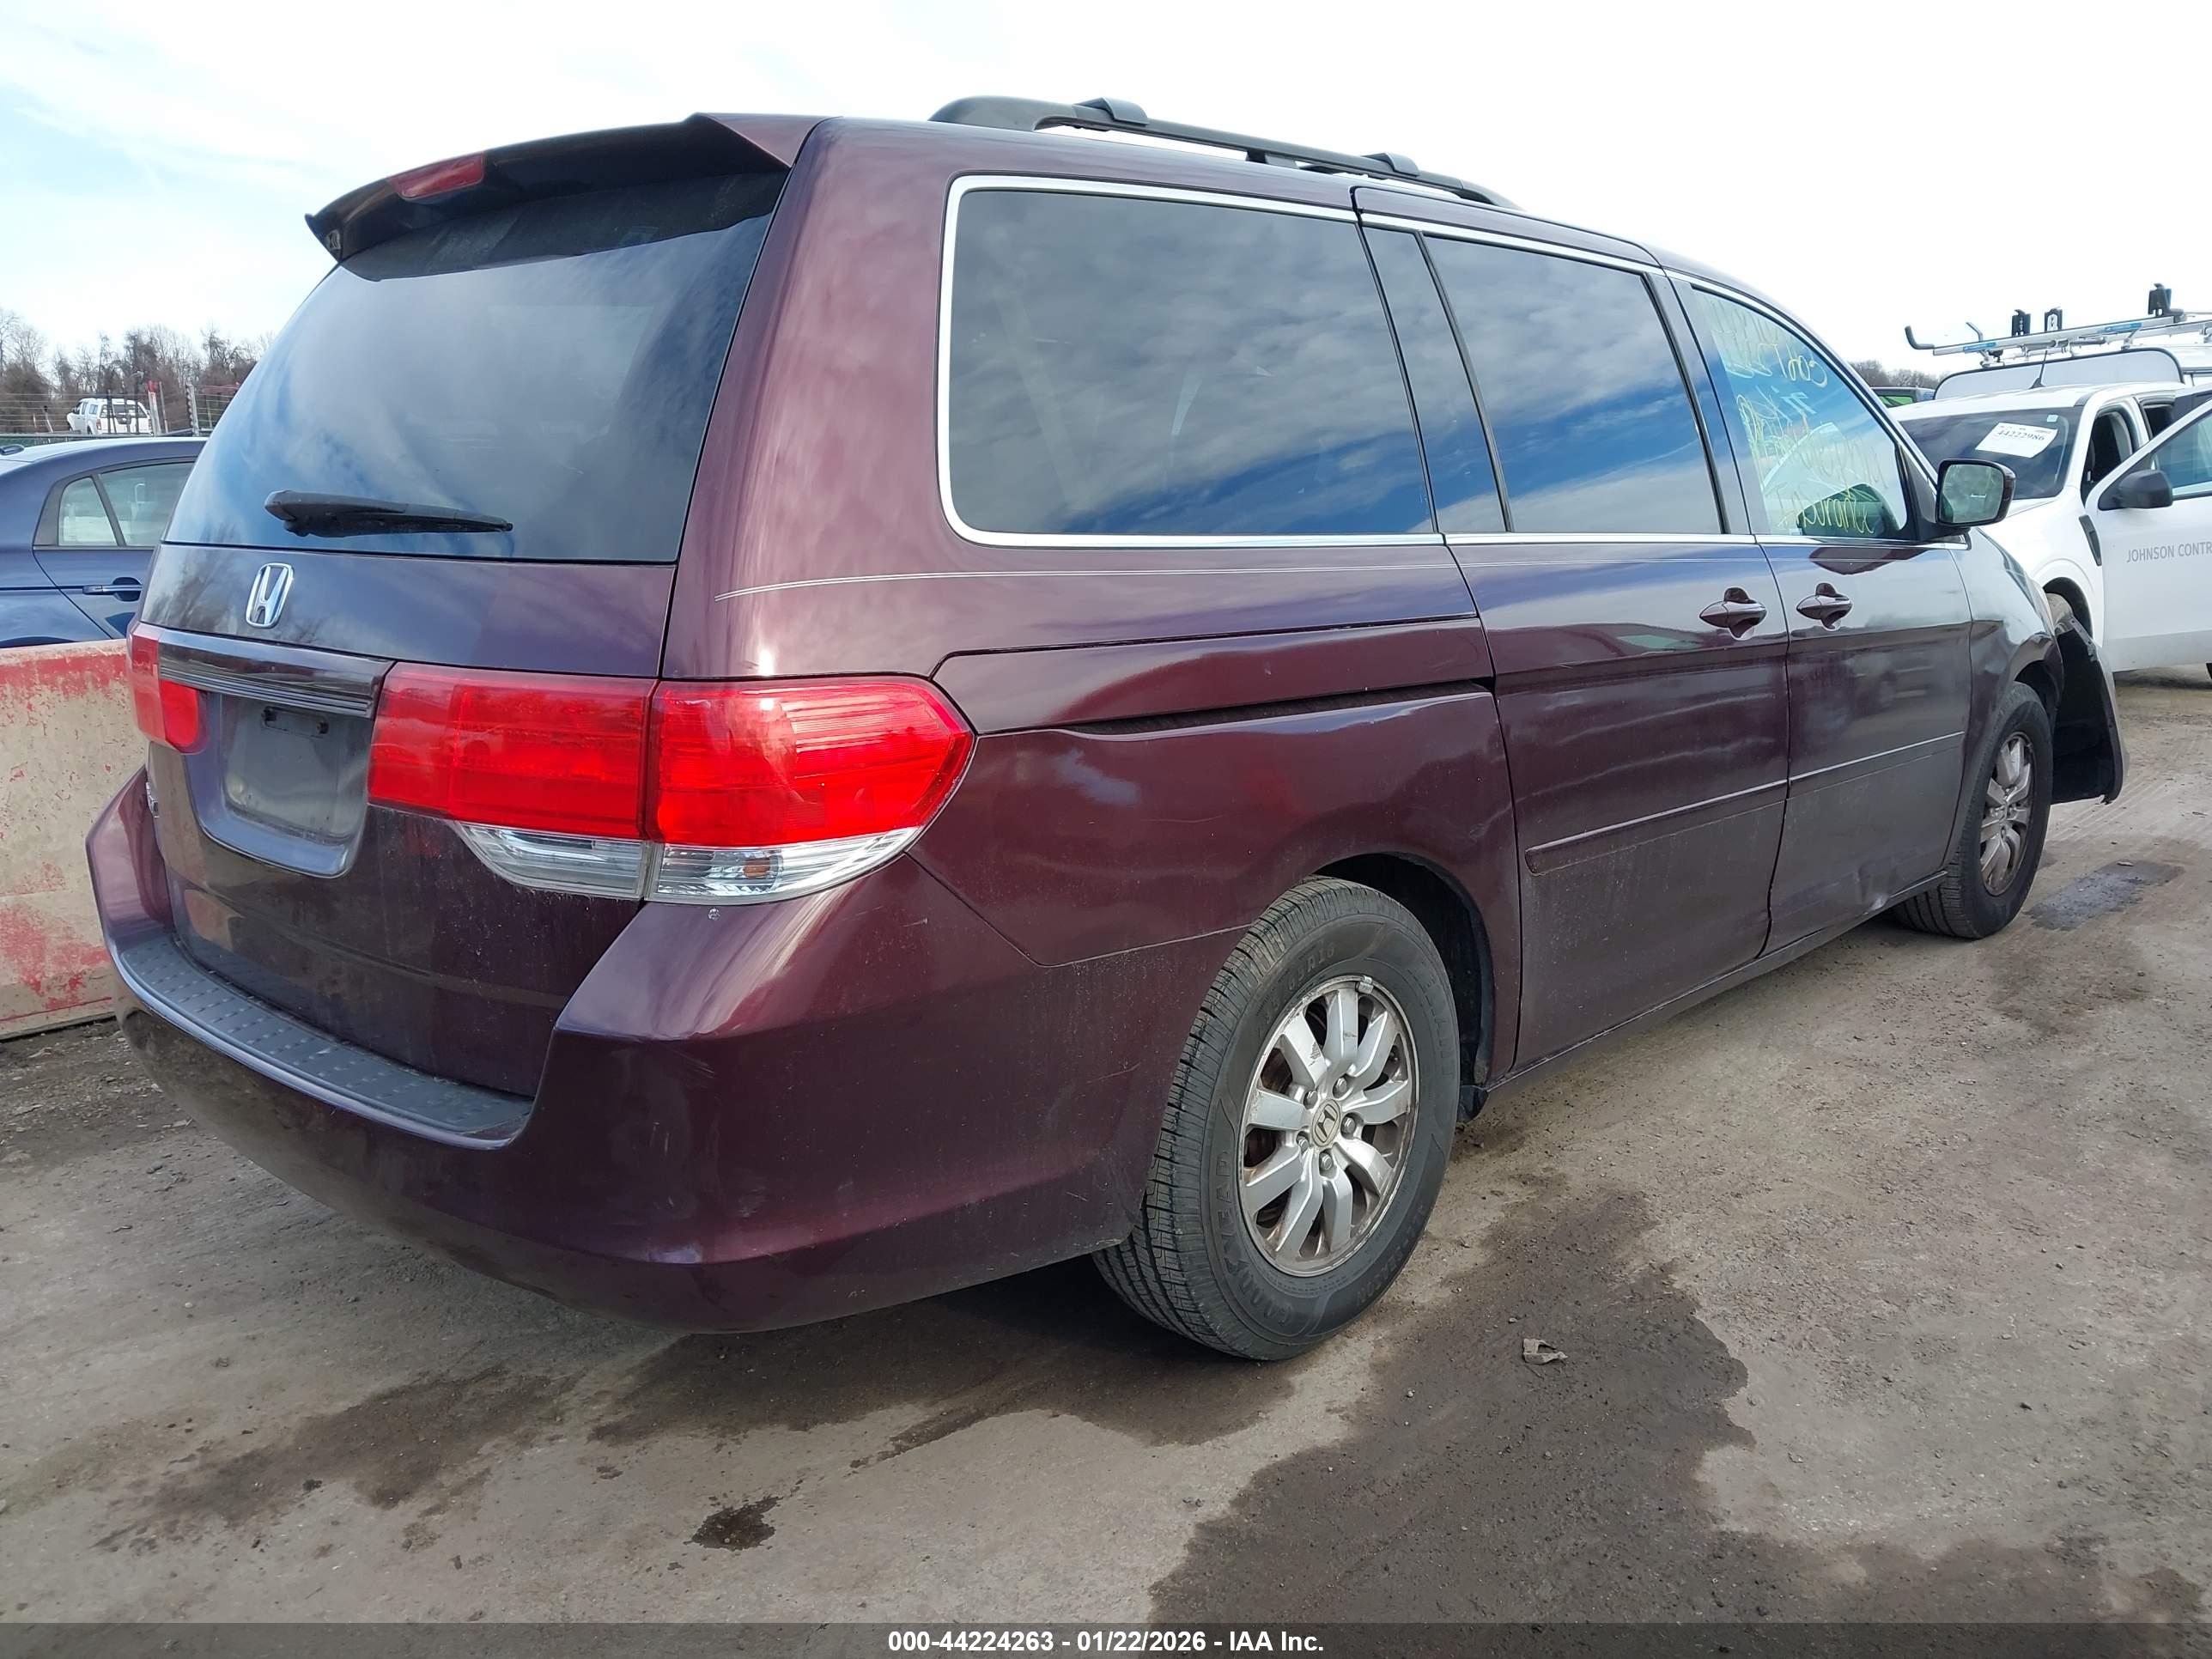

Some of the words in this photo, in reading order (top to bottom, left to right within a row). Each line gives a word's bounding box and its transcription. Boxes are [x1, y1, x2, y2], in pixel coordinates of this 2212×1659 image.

[2127, 545, 2175, 562] JOHNSON
[2179, 542, 2212, 557] CONTR
[1213, 1151, 1294, 1328] GOODYEAR
